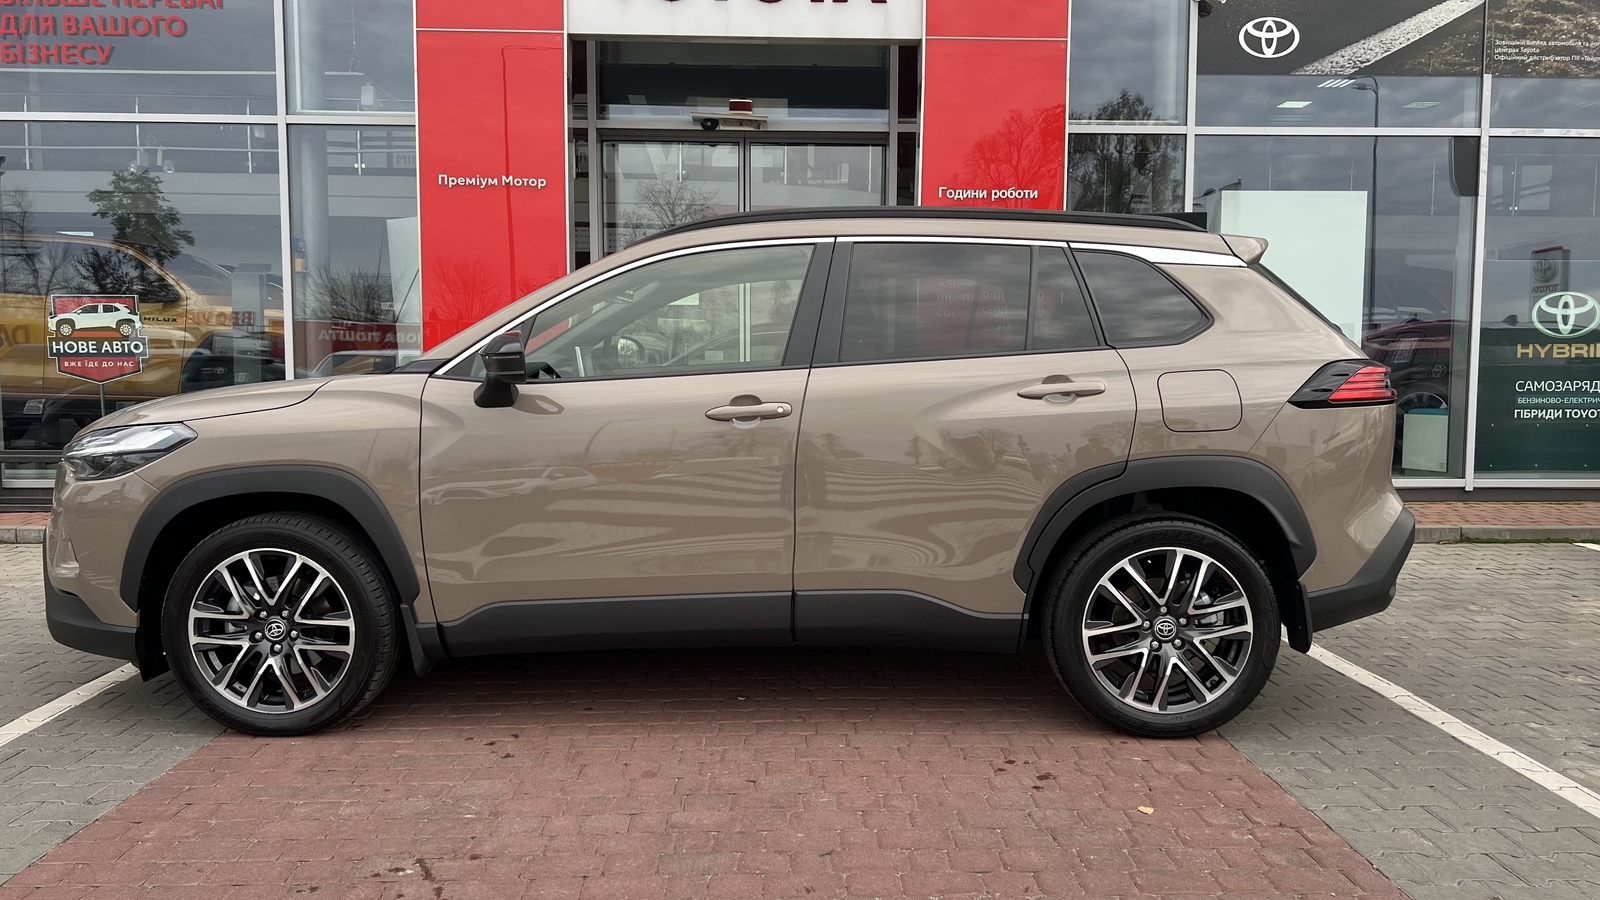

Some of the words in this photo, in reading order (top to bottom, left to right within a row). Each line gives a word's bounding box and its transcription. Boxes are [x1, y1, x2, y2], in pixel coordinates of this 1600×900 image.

[0, 13, 55, 37] ДЛЯ
[62, 14, 186, 36] ВАШОГО
[0, 42, 112, 64] БІЗНЕСУ
[438, 174, 498, 189] Преміум
[501, 175, 547, 190] Мотор
[938, 186, 988, 201] Години
[991, 186, 1039, 202] роботи
[52, 341, 97, 353] НОВЕ
[101, 341, 143, 353] АВТО
[1516, 343, 1600, 359] HYBRI
[85, 360, 99, 368] ЇДЕ
[1514, 409, 1563, 420] ГІБРИДИ
